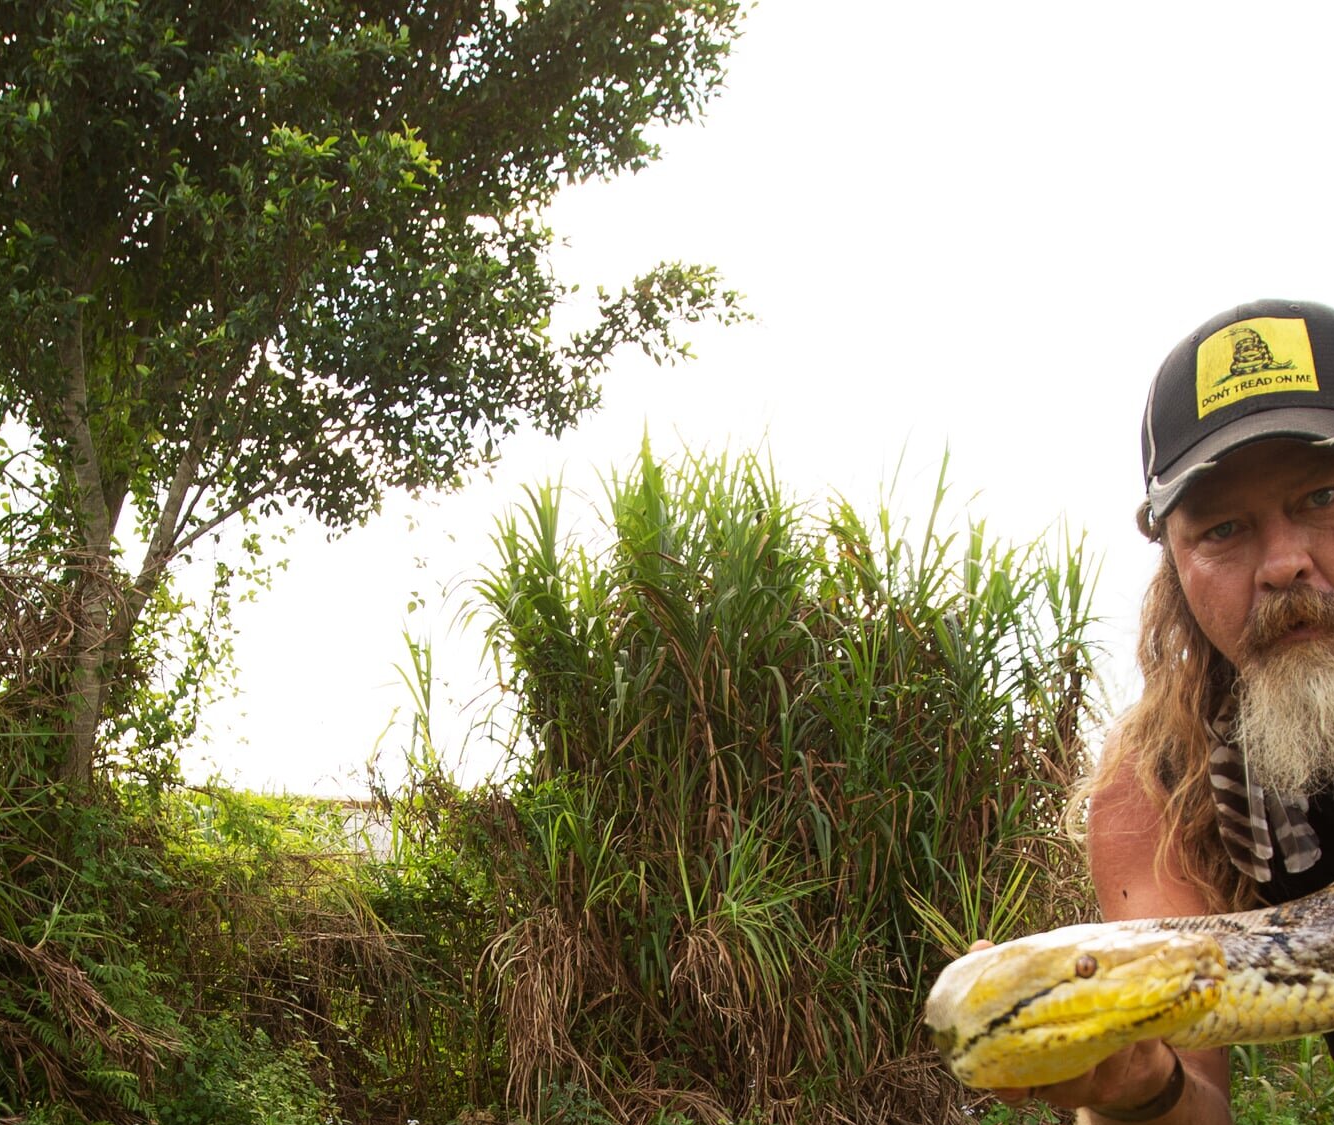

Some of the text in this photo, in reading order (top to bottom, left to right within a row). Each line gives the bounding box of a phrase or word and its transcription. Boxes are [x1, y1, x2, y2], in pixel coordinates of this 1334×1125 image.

[1202, 374, 1312, 408] DON'T TREAD ON ME
